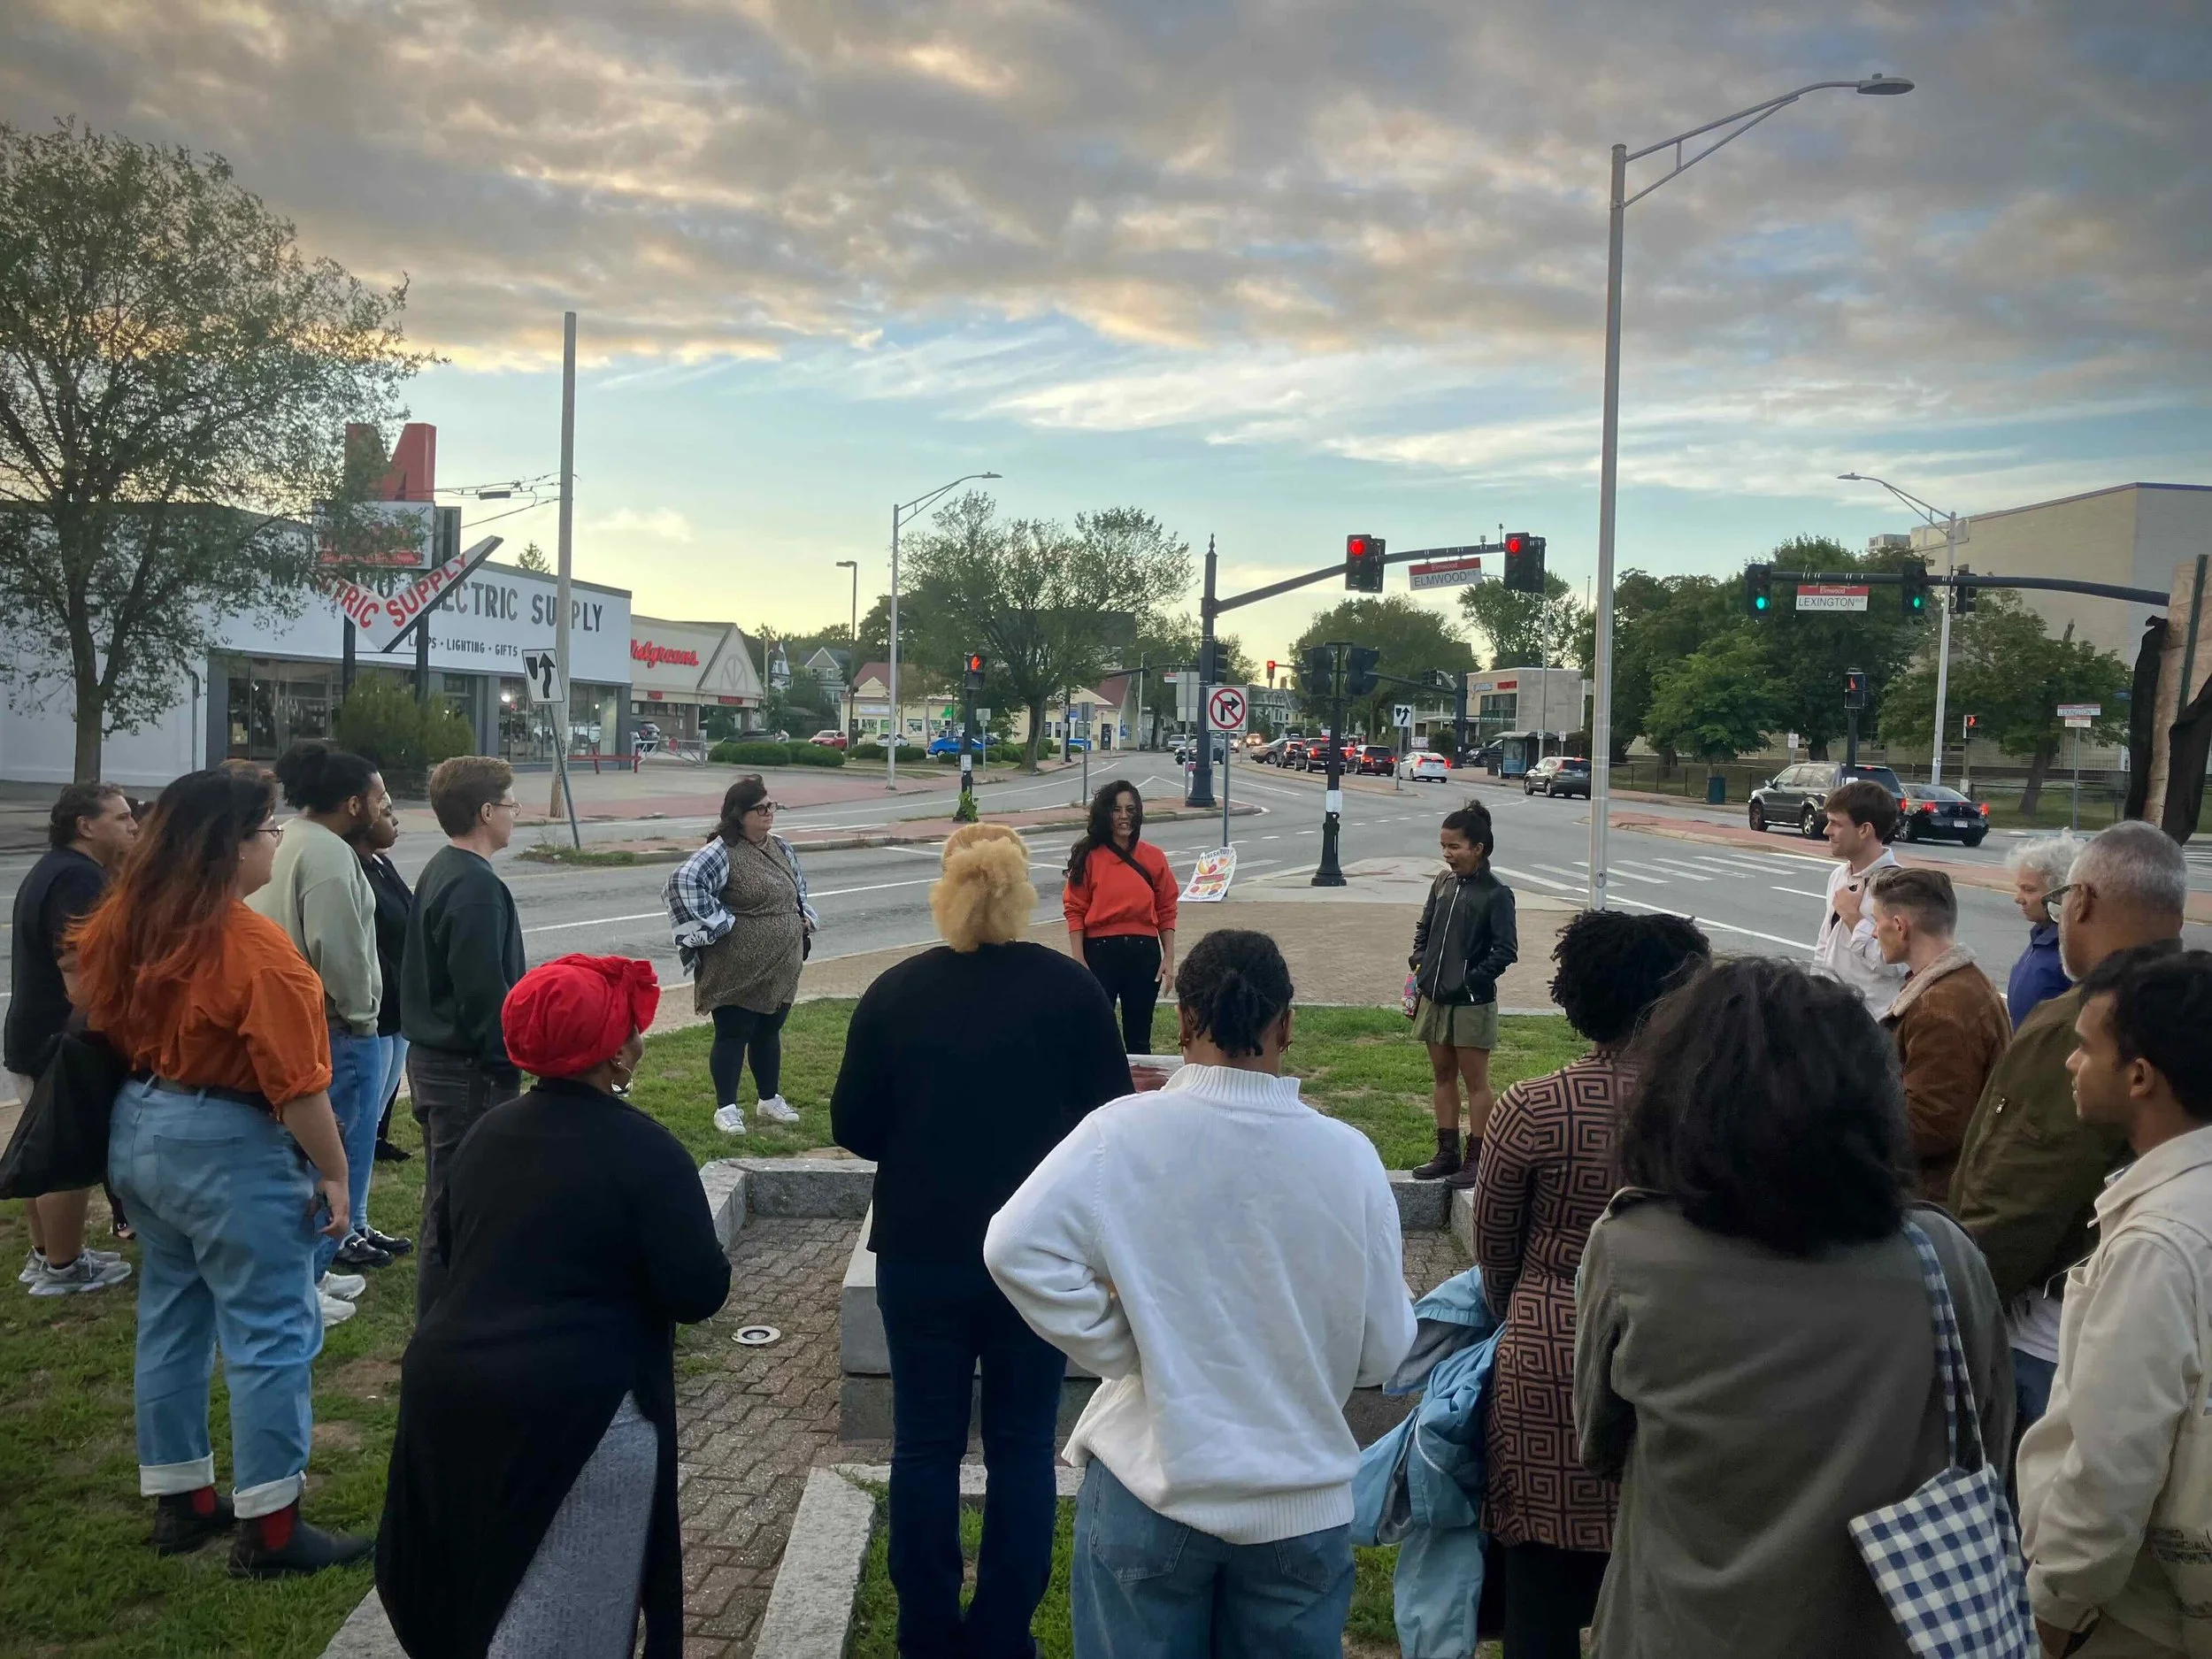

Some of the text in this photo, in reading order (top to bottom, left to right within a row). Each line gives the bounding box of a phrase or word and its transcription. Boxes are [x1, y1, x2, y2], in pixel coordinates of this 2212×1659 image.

[1431, 562, 1458, 572] Elmwood
[1414, 572, 1467, 587] ELMWOOD
[386, 552, 468, 627] SUPPLY
[1819, 586, 1846, 595] Elmwood
[435, 580, 518, 621] ECTRIC
[531, 594, 603, 633] SUPLY
[1798, 597, 1855, 607] LEXINGTON
[408, 634, 518, 657] LPS LIGHTING GIFTS
